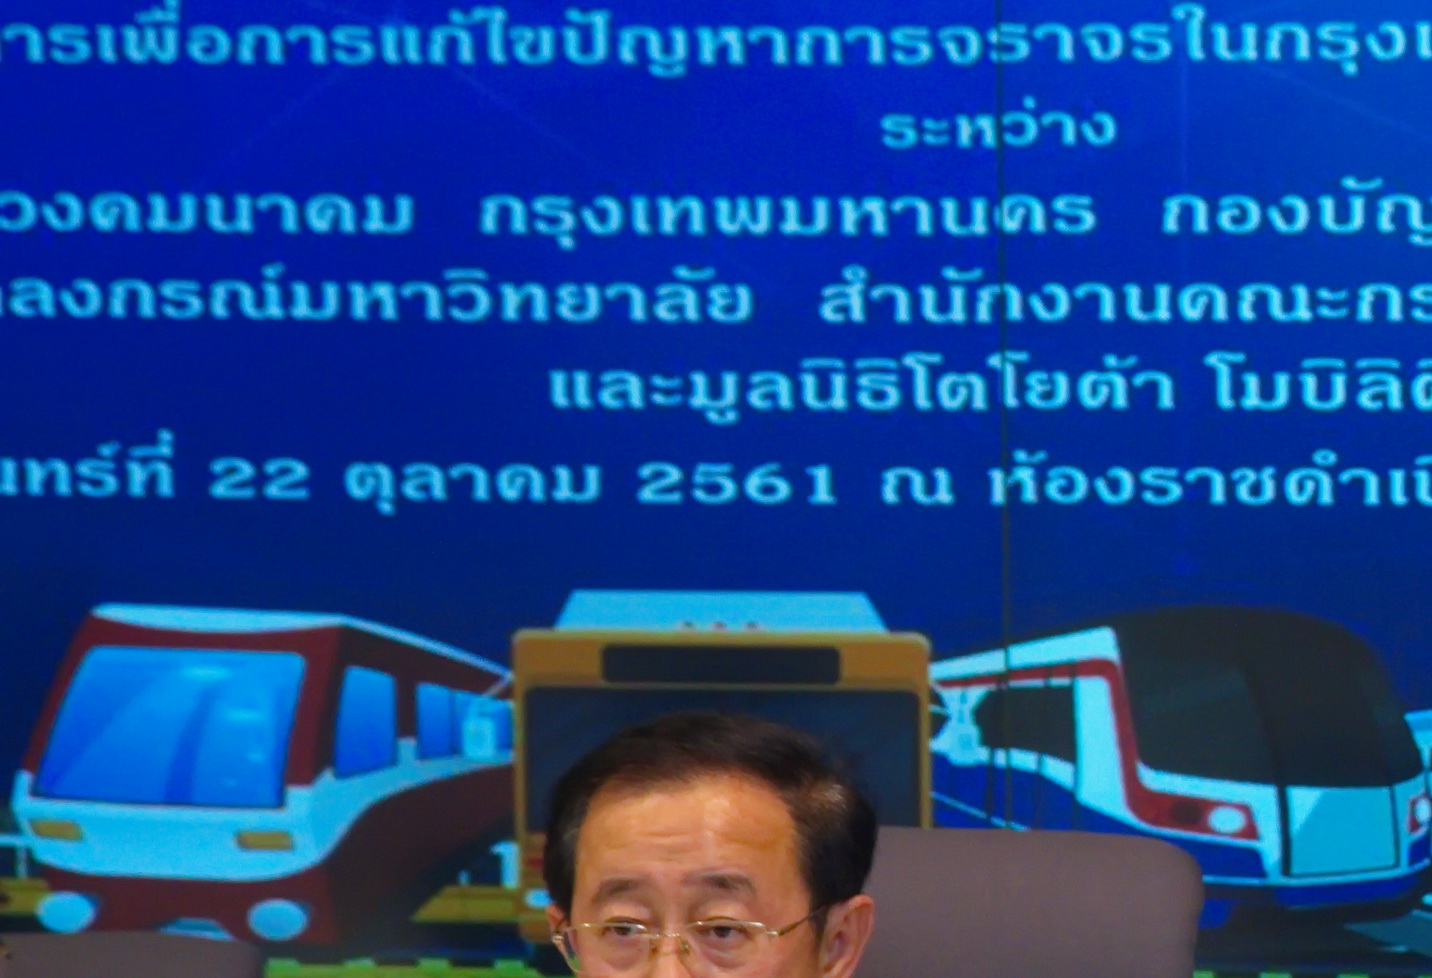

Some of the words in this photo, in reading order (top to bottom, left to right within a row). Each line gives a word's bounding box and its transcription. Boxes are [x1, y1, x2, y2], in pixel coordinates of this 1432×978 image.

[879, 94, 1119, 150] ระหว่าง
[0, 189, 415, 236] วงคมนาคม
[479, 192, 1099, 252] กรุงเทพมหานคร
[0, 262, 755, 325] ลงกรณ์มหาวิทยาลัย
[548, 348, 1177, 427] และมูลนิธิโตโยต้า
[208, 455, 311, 501] 22
[343, 461, 603, 517] ตุลาคม
[636, 460, 838, 506] 2561
[880, 465, 956, 507] ณ
